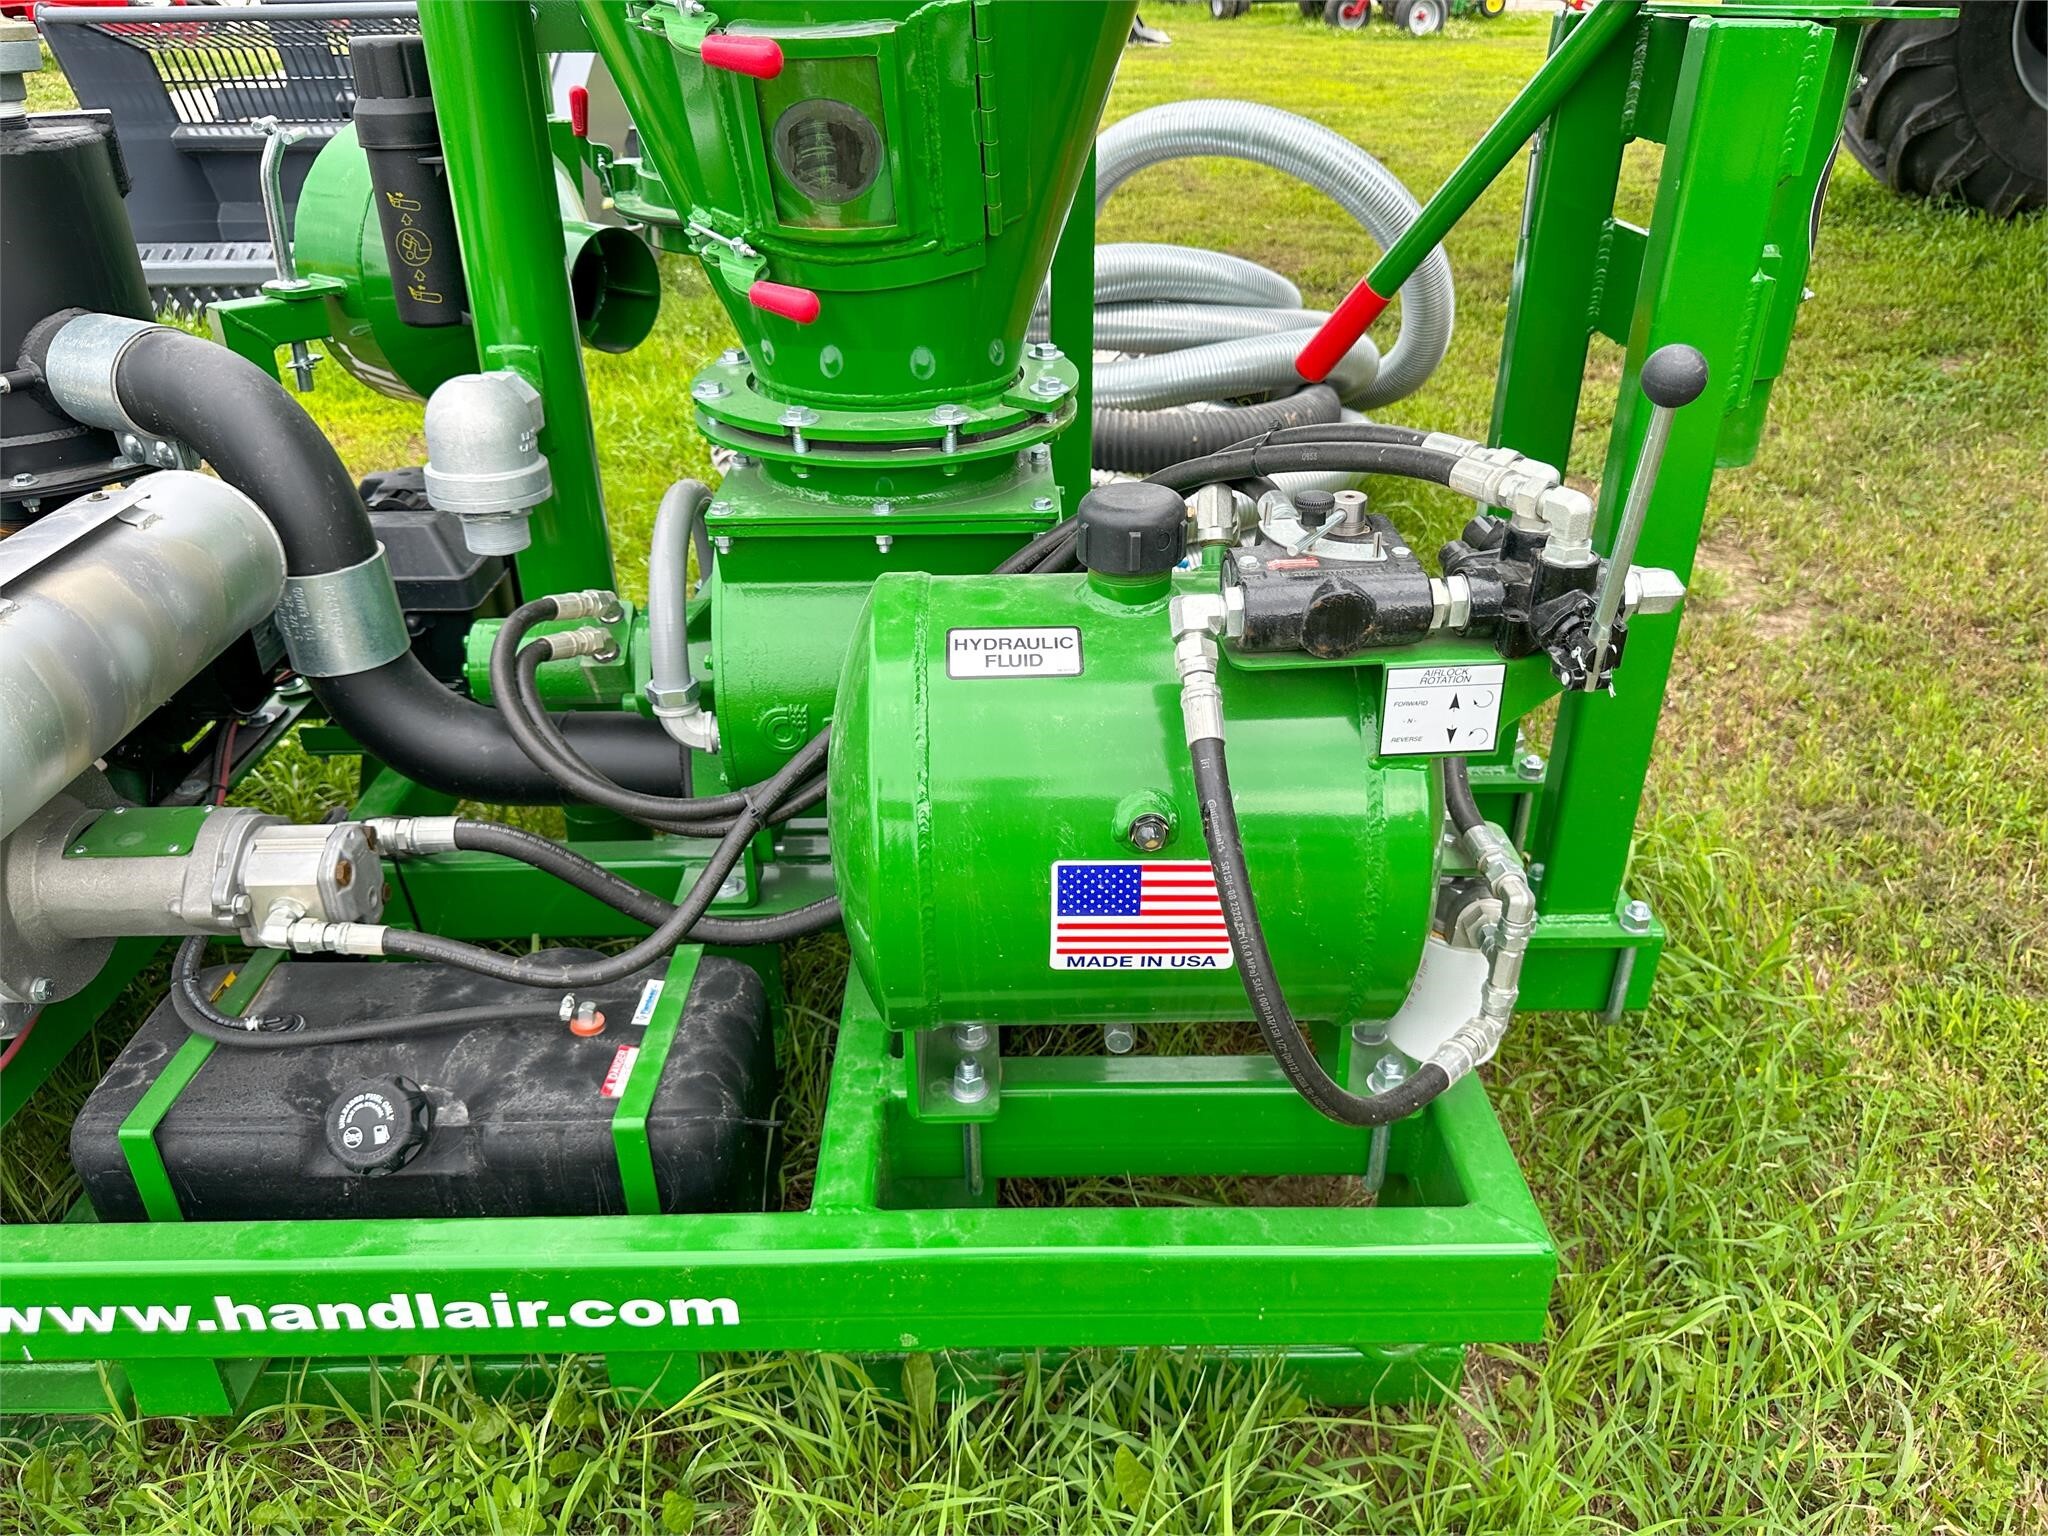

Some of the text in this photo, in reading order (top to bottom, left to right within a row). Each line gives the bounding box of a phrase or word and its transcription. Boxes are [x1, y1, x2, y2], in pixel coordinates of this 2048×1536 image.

[954, 636, 1074, 651] HYDRAULIC
[985, 653, 1044, 668] FLUID
[1423, 667, 1470, 677] AIRLOCK
[1419, 675, 1472, 685] ROTATION
[1390, 735, 1424, 743] REVERSE
[1066, 955, 1217, 968] MADE IN USA
[338, 1094, 365, 1130] UNLEADED
[364, 1092, 384, 1104] FUEL
[381, 1100, 395, 1121] ONLY
[0, 1292, 741, 1333] www.handlair.com
